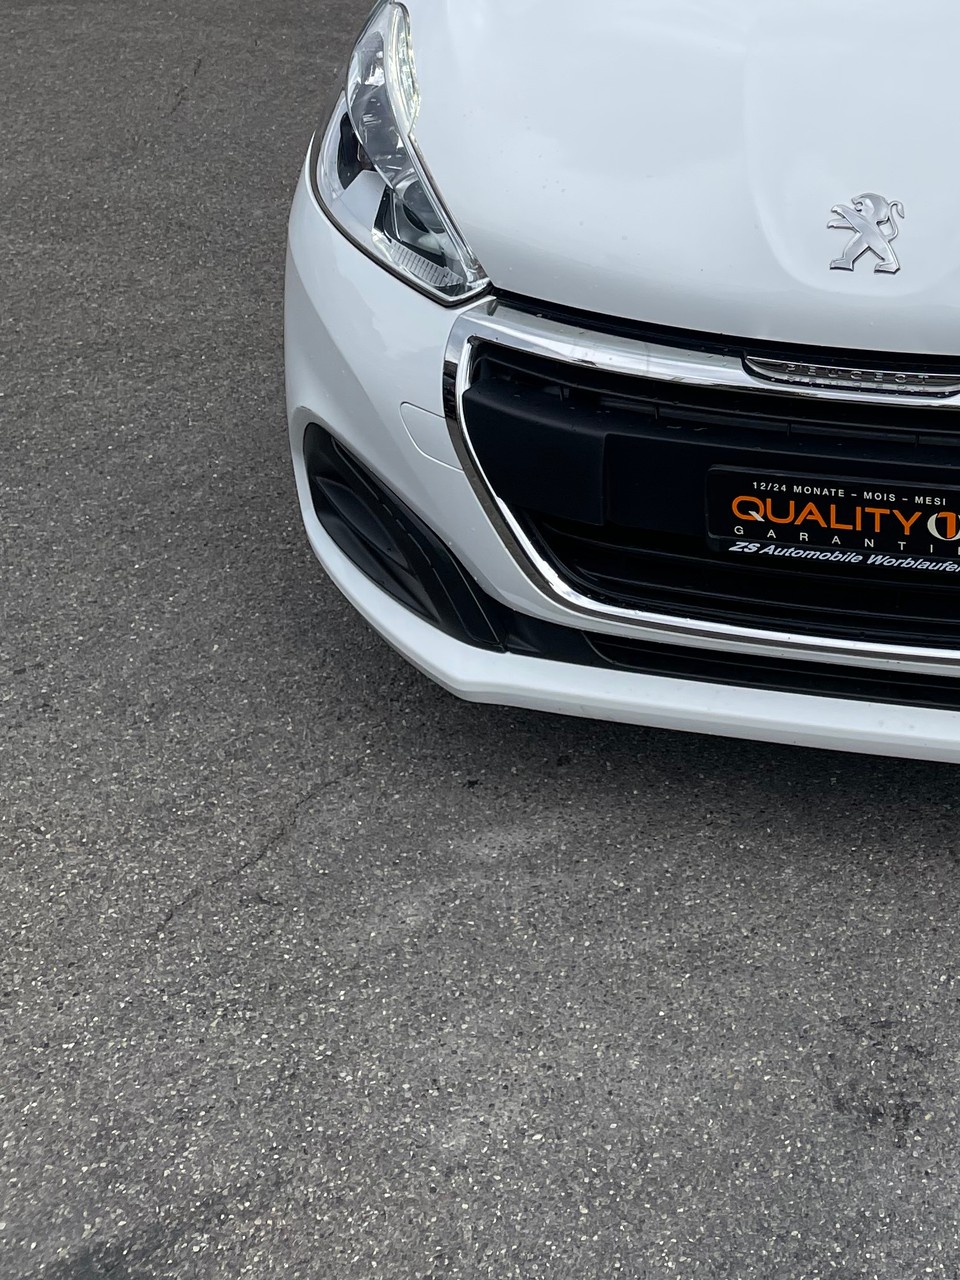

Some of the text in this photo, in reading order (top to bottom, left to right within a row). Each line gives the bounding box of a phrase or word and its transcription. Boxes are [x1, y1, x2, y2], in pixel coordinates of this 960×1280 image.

[752, 481, 787, 492] 12/24
[793, 485, 845, 497] MONATE
[863, 491, 896, 502] MOIS
[914, 495, 946, 506] MESI
[731, 495, 922, 536] QUALITY
[758, 542, 864, 564] Automobile
